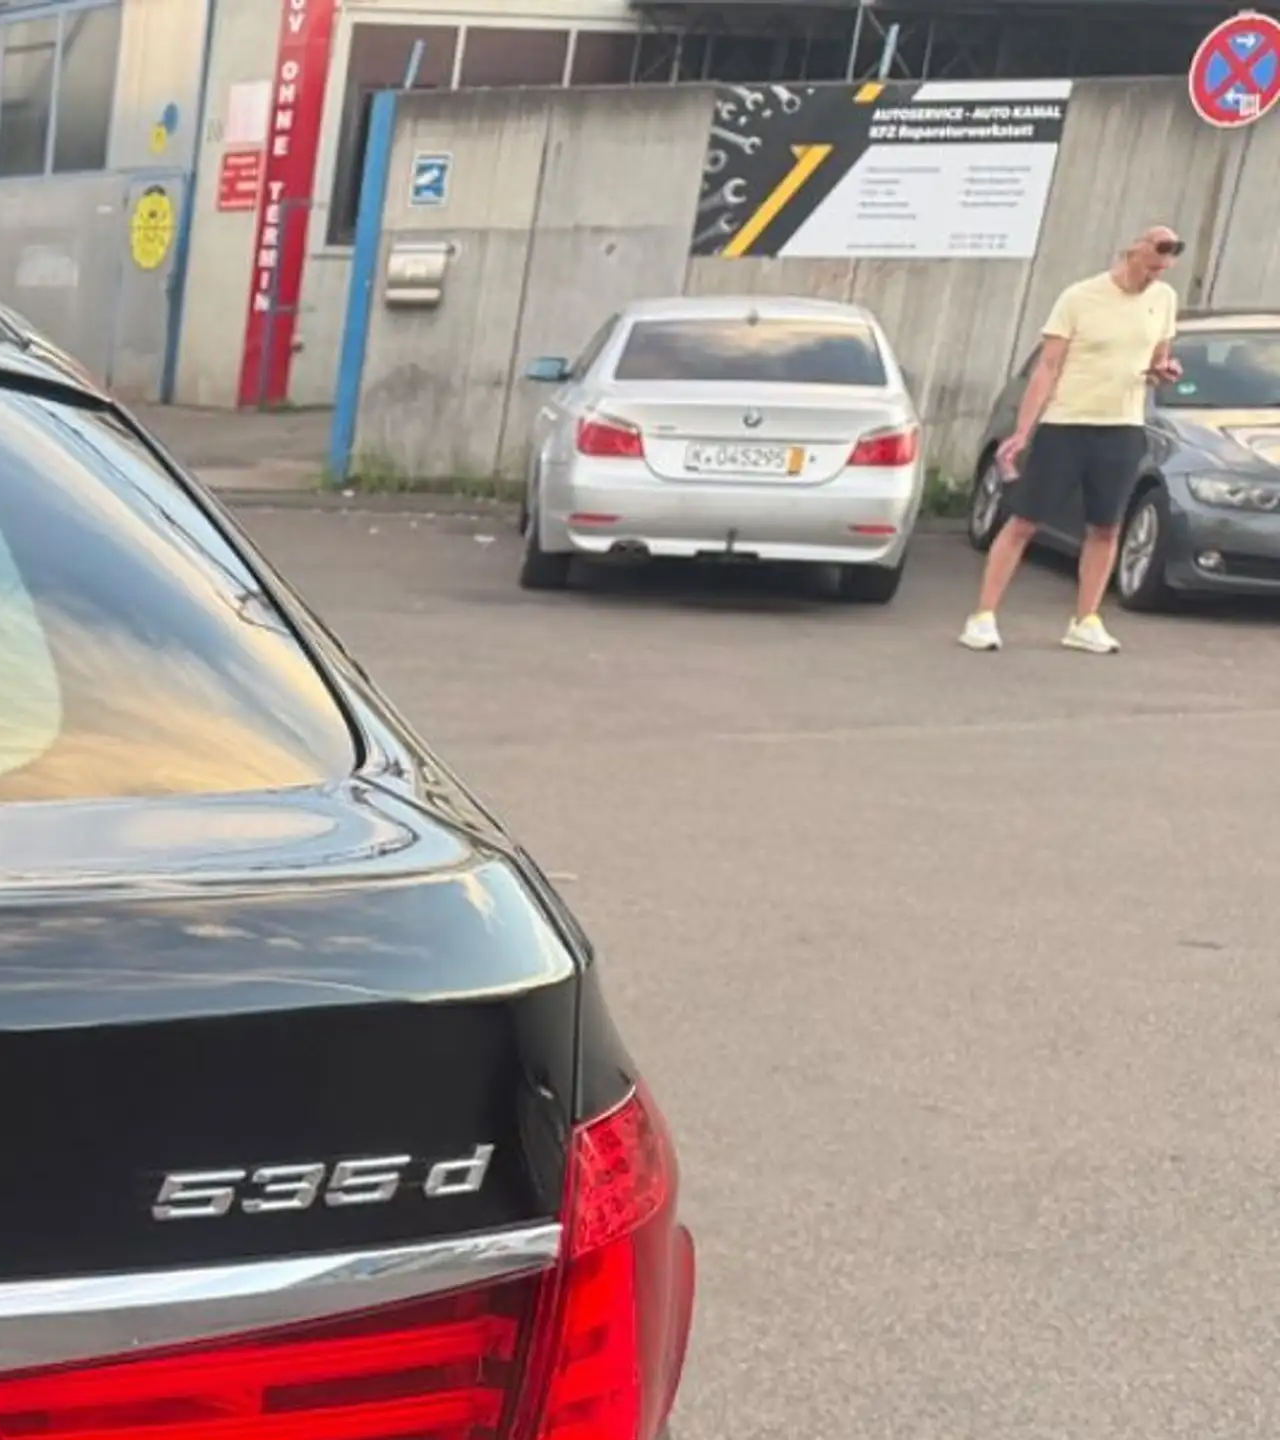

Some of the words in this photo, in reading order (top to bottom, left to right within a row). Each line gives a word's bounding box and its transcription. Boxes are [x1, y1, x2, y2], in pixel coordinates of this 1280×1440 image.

[273, 60, 300, 156] OHNE
[869, 125, 896, 139] KFZ
[898, 123, 1034, 140] Reparaturwerkstatt
[872, 107, 964, 121] AUTOSERVICE
[971, 106, 1011, 120] AUTO
[253, 181, 285, 312] TERMIN
